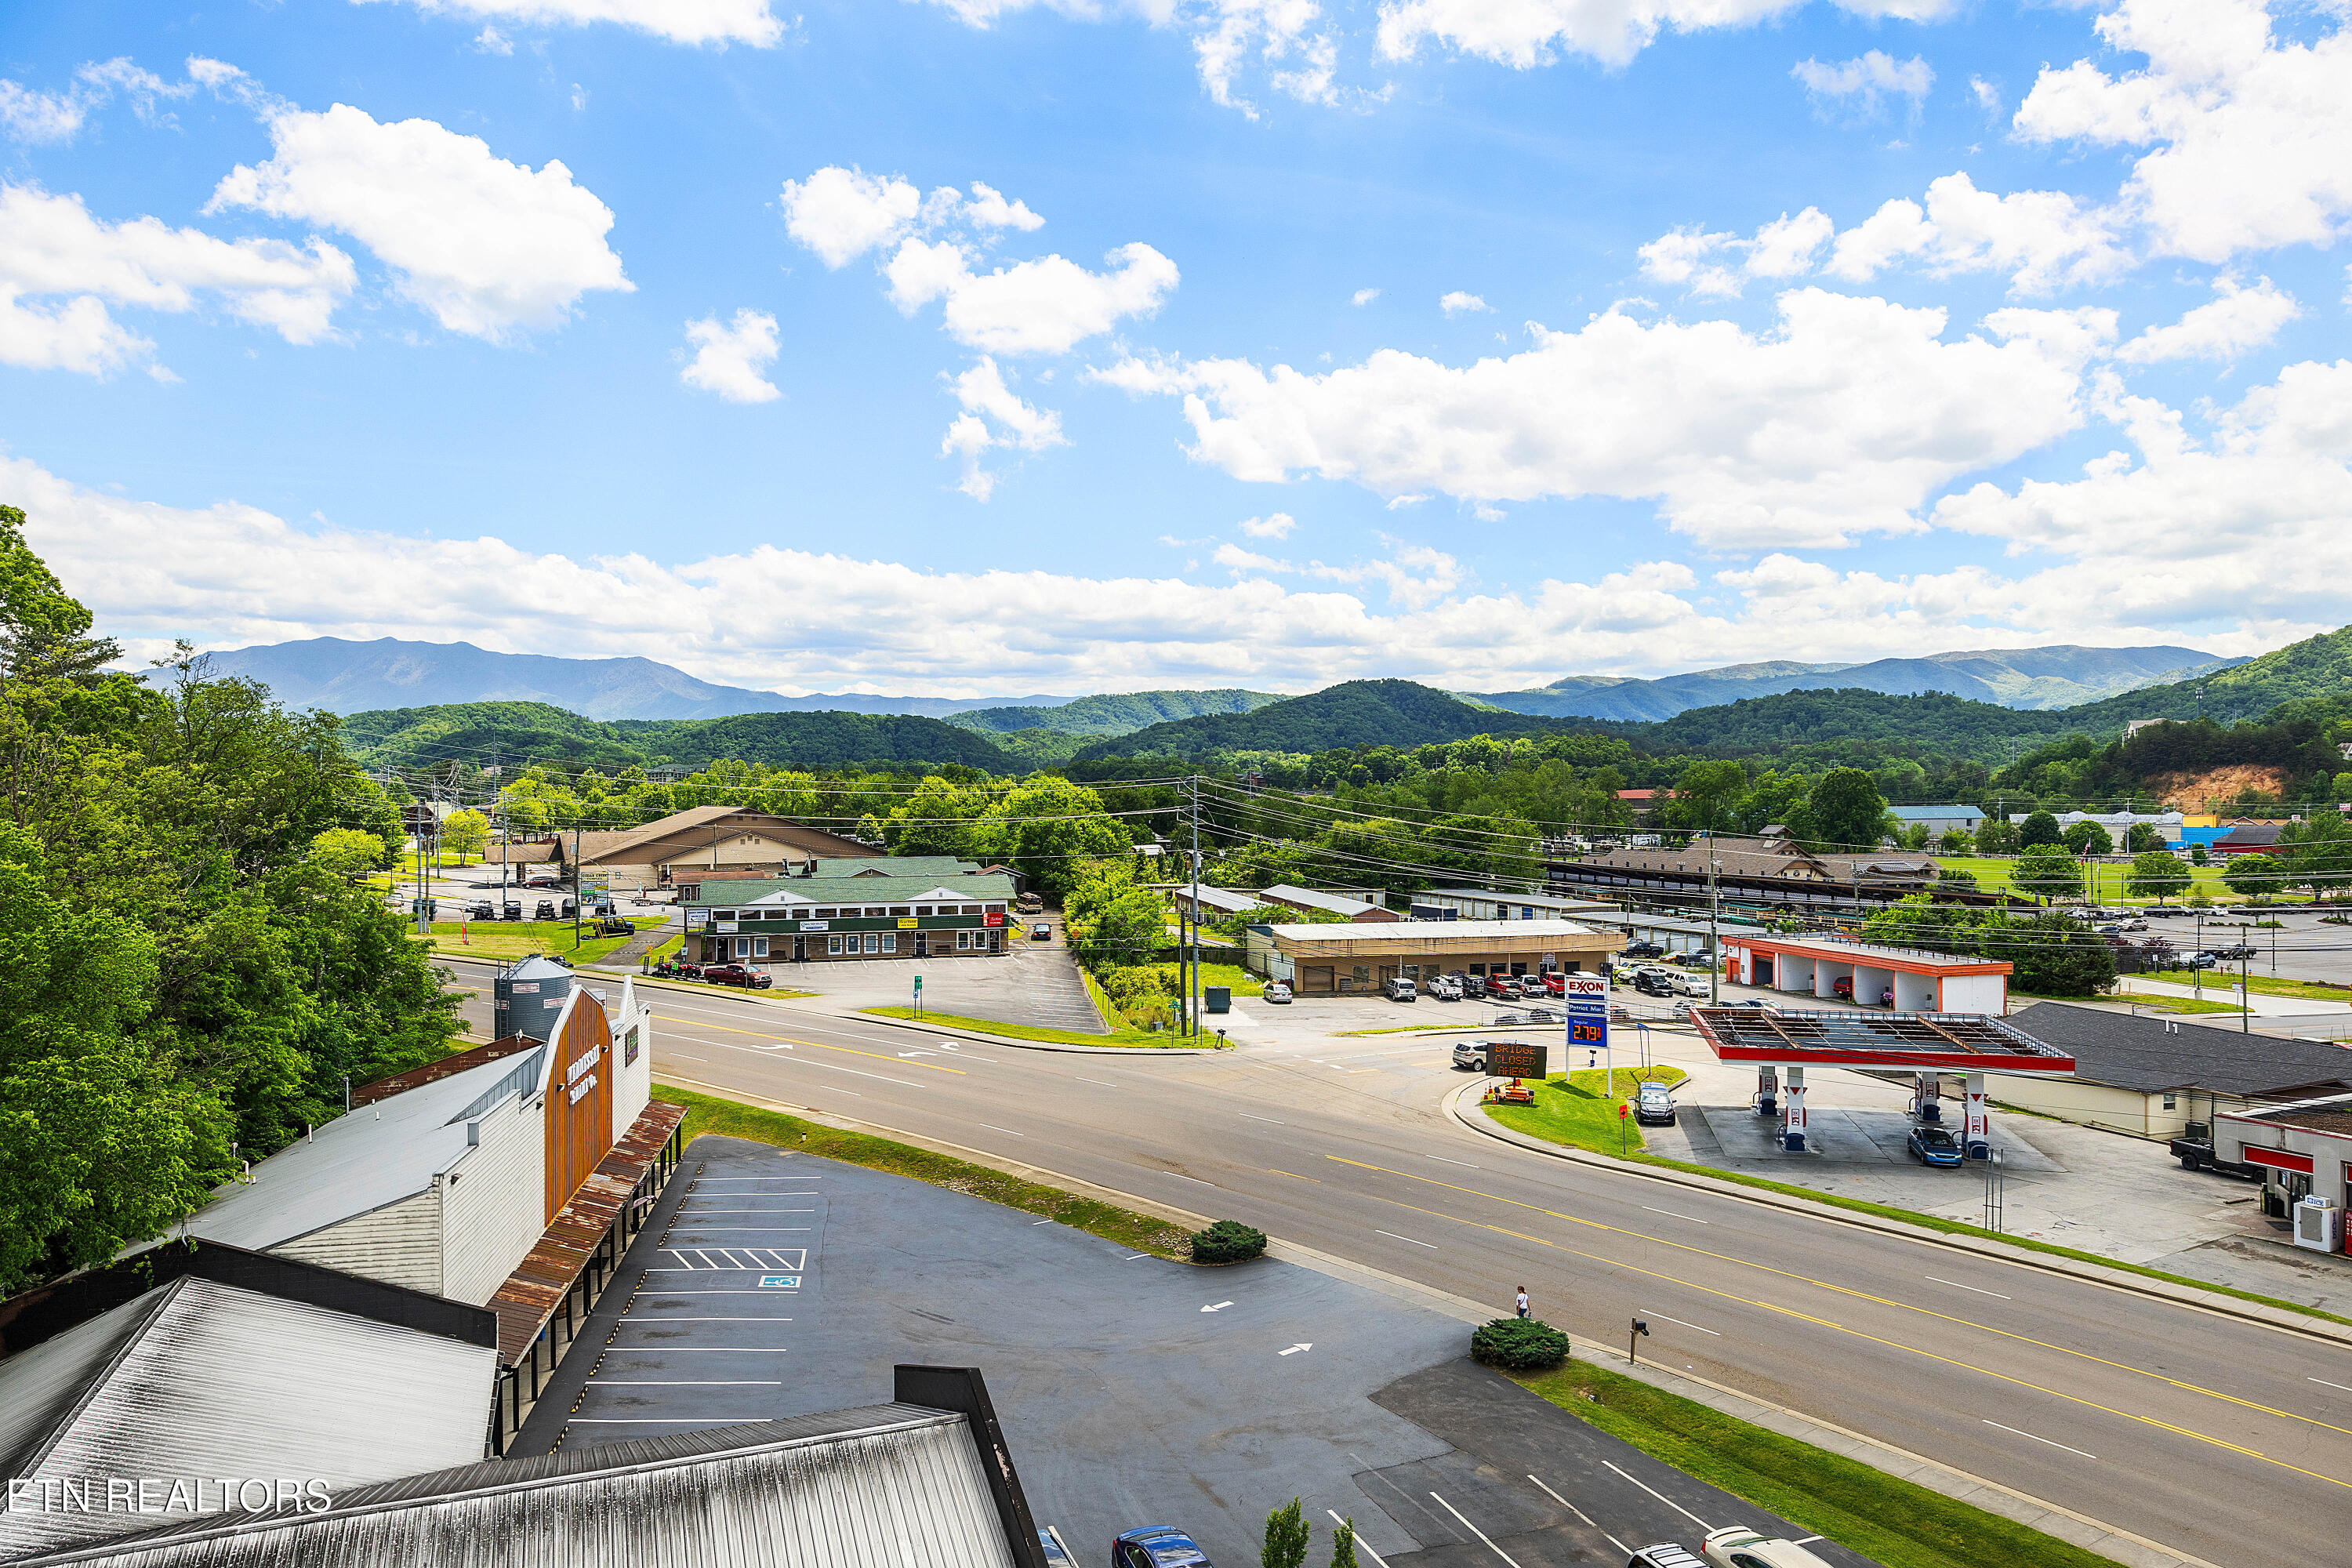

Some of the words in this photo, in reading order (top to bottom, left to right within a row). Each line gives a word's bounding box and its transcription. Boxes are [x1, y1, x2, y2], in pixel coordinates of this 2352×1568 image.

[1569, 981, 1604, 994] EXXON
[1495, 1044, 1537, 1055] BRIDGE
[1494, 1054, 1537, 1065] CLOSED
[1497, 1065, 1533, 1077] AHEAD
